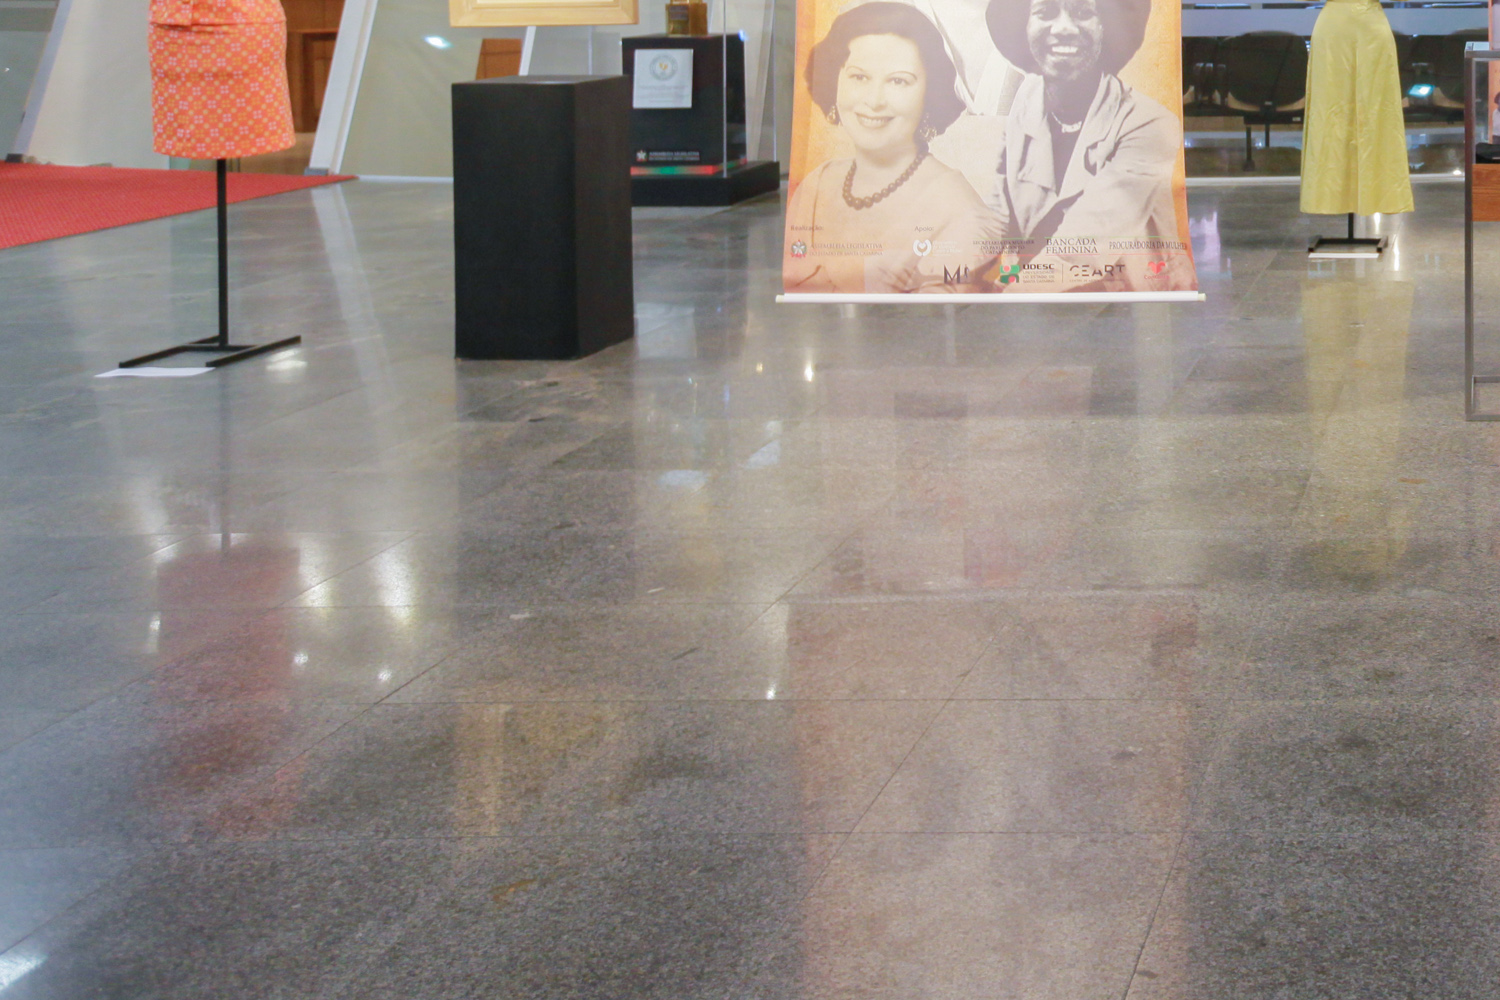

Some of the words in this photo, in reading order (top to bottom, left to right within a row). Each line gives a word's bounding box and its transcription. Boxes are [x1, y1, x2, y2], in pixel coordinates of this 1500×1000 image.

[1046, 238, 1097, 246] BANCADA
[1109, 241, 1155, 250] PROCURADORIA
[1046, 246, 1098, 254] FEMININA
[1069, 264, 1126, 277] CEART
